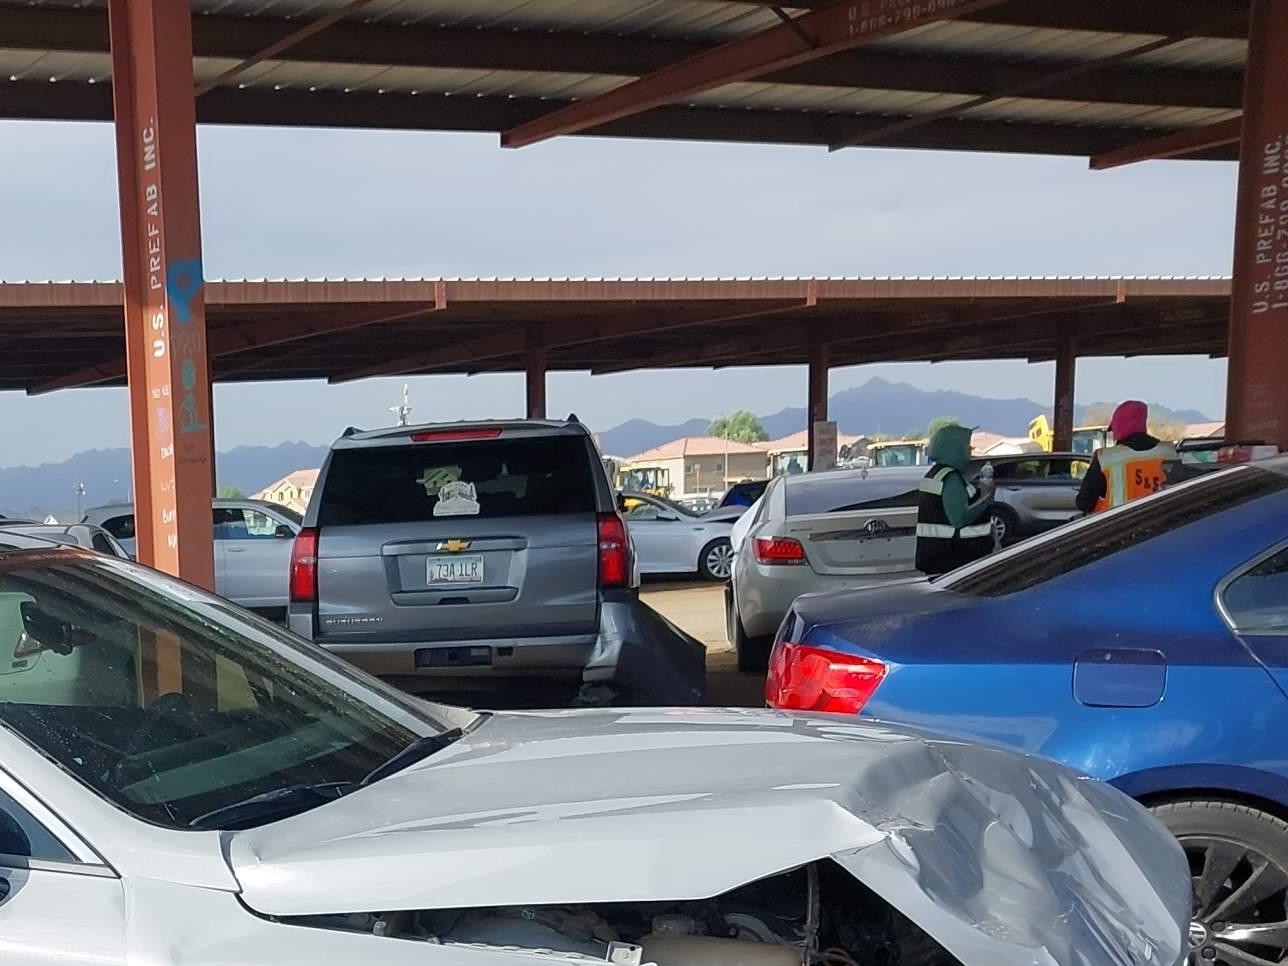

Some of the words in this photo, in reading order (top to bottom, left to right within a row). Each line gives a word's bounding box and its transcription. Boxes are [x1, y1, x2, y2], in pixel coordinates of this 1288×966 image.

[142, 117, 156, 171] INC.
[1262, 134, 1282, 174] INC.
[146, 184, 162, 289] PREFAB
[1256, 185, 1277, 264] PREFAB
[1252, 274, 1272, 314] U.S.
[152, 304, 165, 358] U.S.
[437, 563, 455, 578] 73A
[459, 562, 478, 577] 1LR
